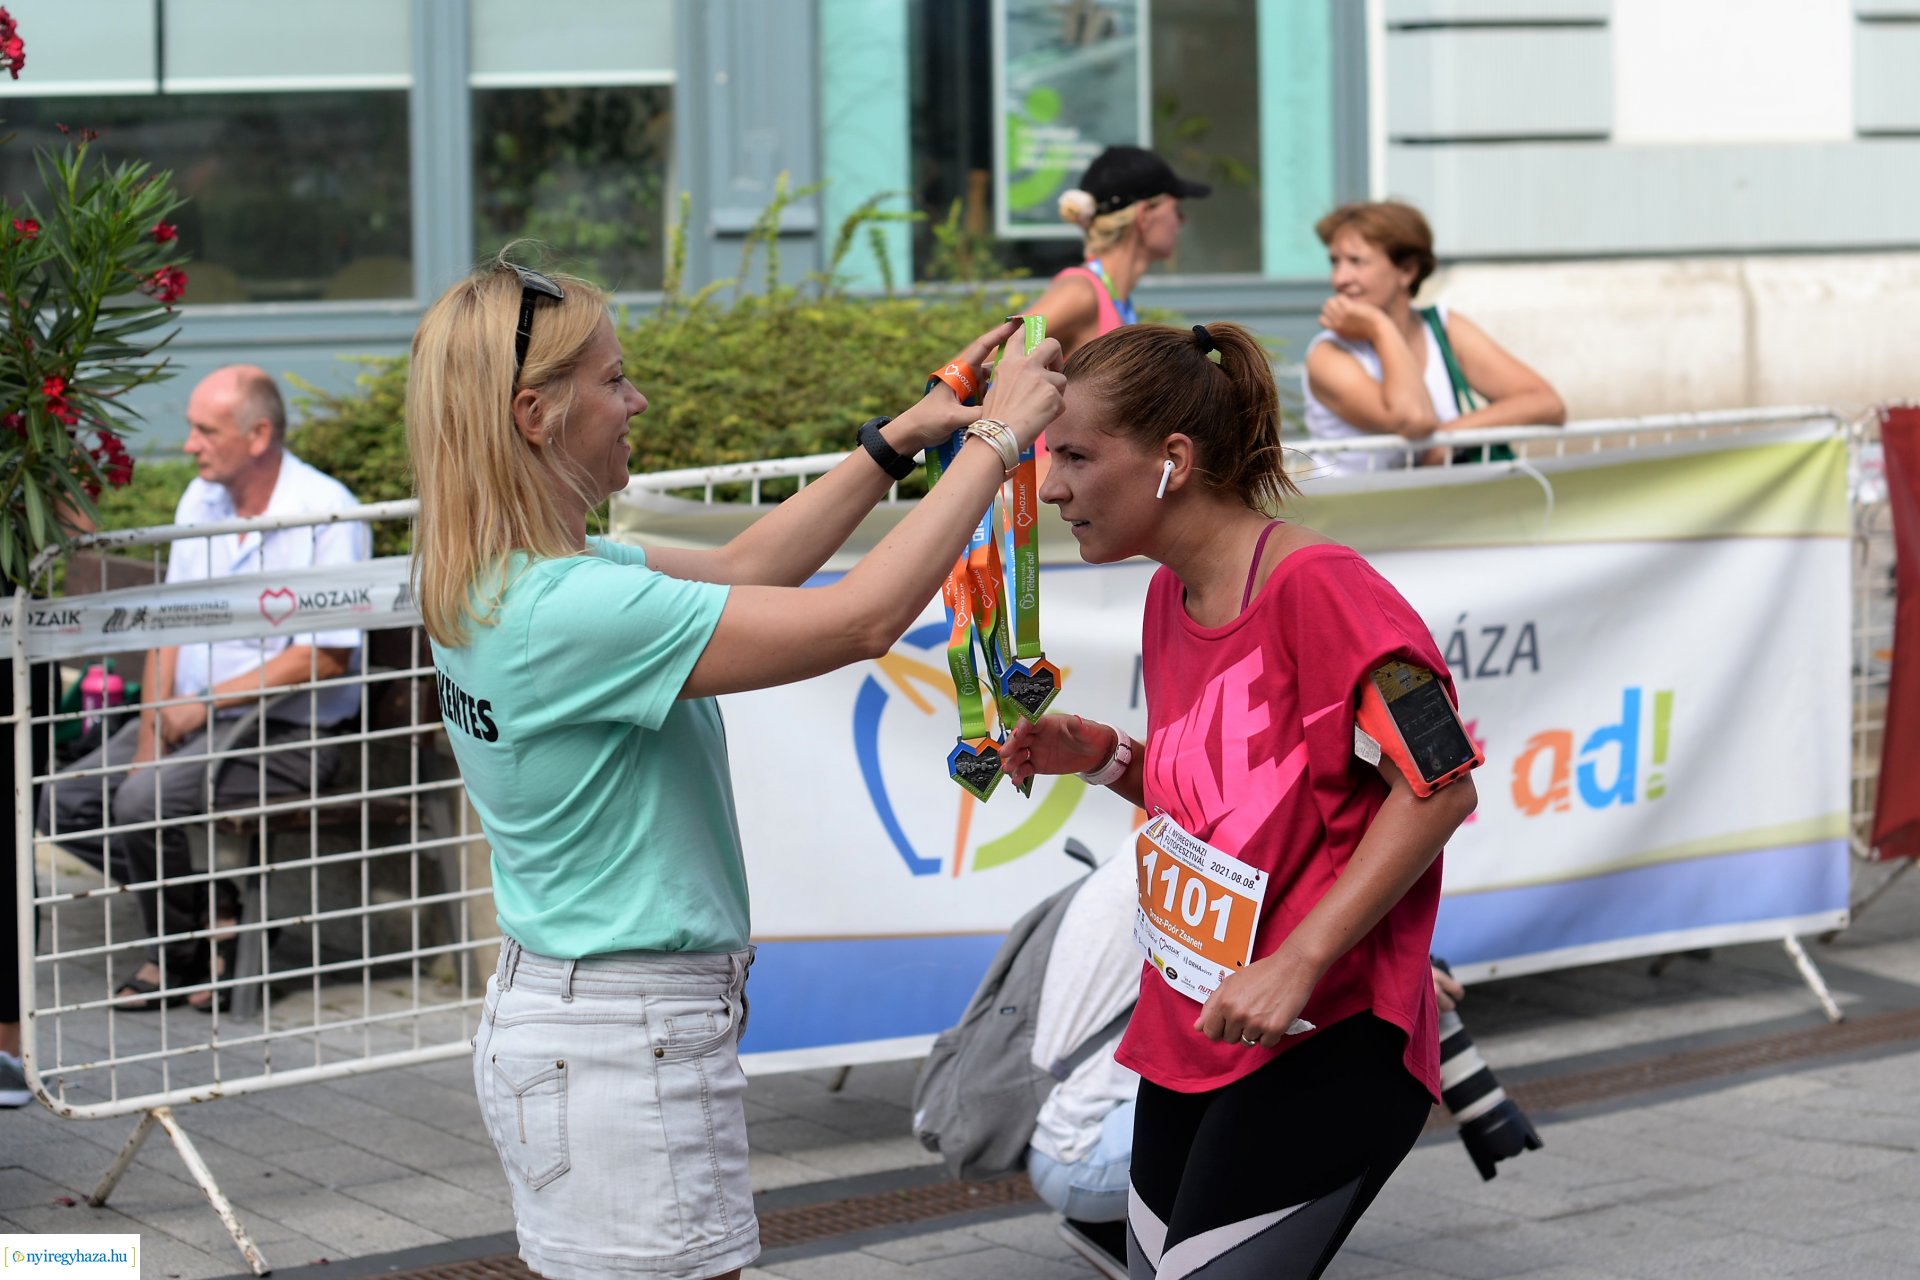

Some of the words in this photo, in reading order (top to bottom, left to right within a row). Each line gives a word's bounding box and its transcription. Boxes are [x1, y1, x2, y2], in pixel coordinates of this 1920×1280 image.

[1027, 566, 1035, 593] Többet
[299, 588, 371, 609] MOZAIK
[1, 610, 81, 628] MZAIK
[1444, 612, 1541, 681] ÁZA
[435, 665, 499, 742] KÉNTES
[1509, 686, 1675, 818] ad!
[1172, 829, 1208, 857] NYÍREGYHÁZI
[1210, 861, 1256, 891] 2021.08.08.
[1142, 849, 1234, 943] 1101
[1178, 929, 1204, 951] Zsanett
